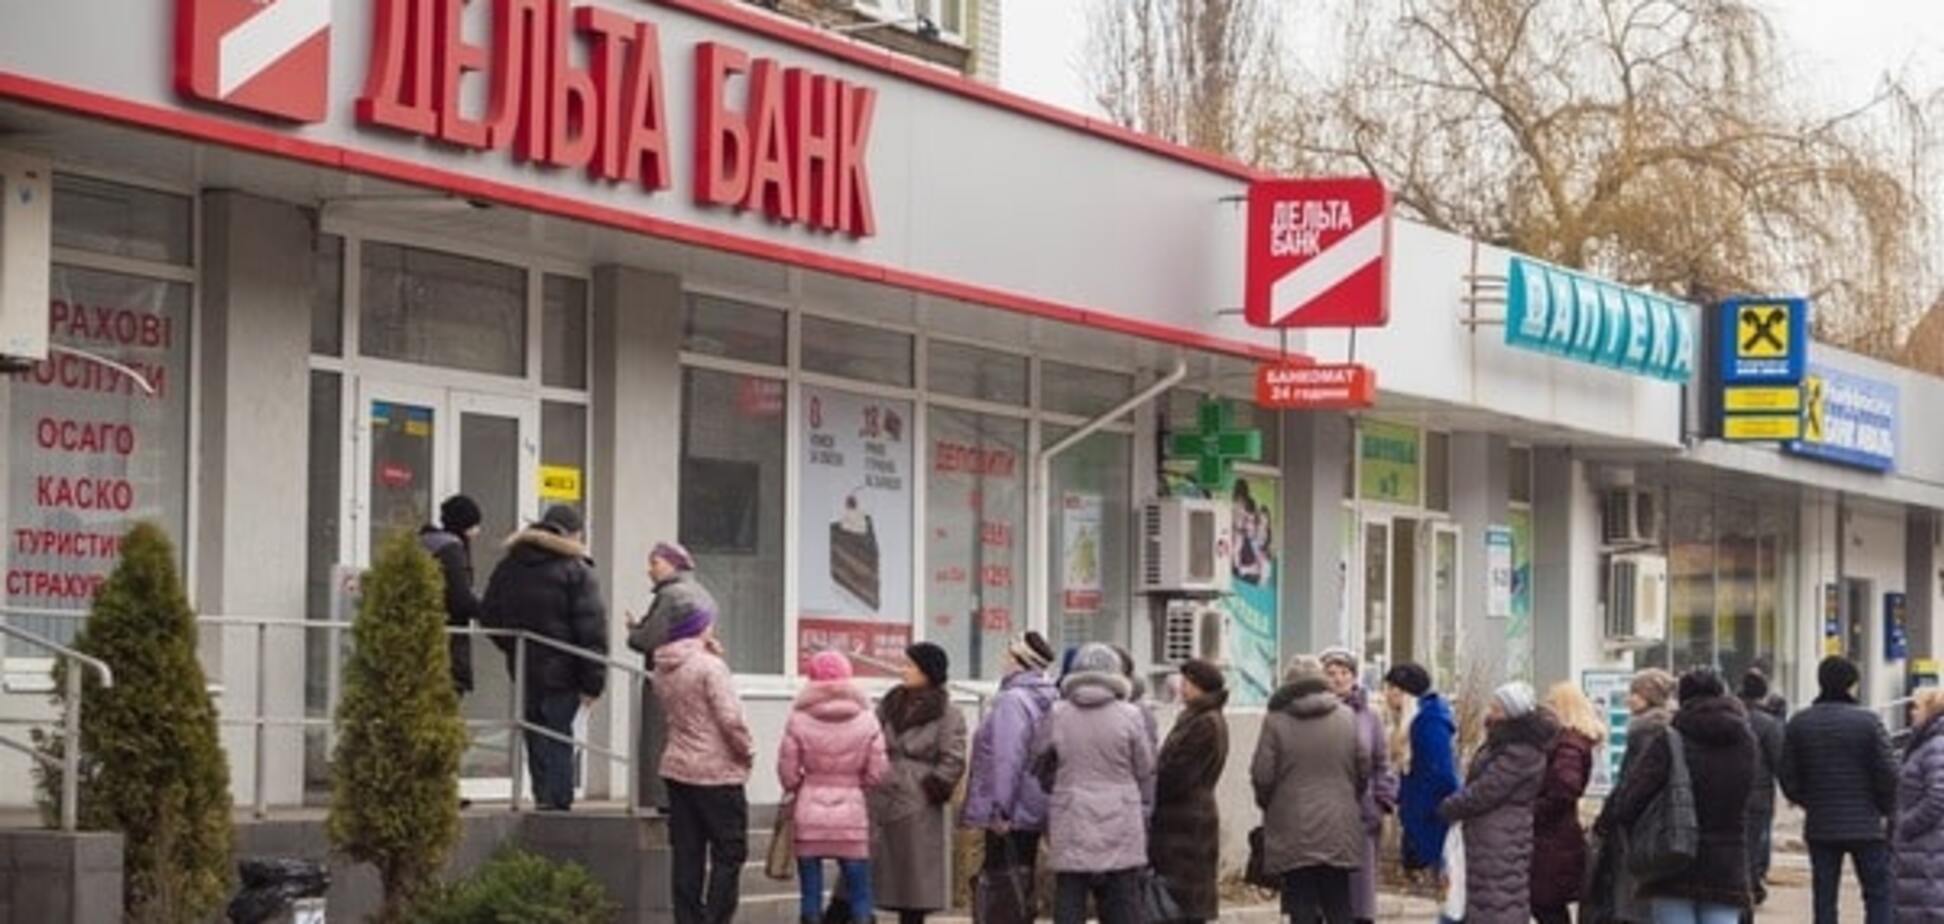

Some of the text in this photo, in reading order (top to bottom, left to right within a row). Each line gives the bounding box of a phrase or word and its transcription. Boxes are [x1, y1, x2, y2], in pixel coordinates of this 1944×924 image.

[357, 0, 877, 238] ДЕЛЬТА БАНК
[1270, 200, 1353, 231] ДЕЛЬТА
[1270, 230, 1321, 257] БАНК
[50, 300, 172, 348] РАХОВІ
[1266, 369, 1354, 384] БАНКОМАТ
[37, 417, 134, 456] ОСАГО
[37, 475, 134, 511] КАСКО
